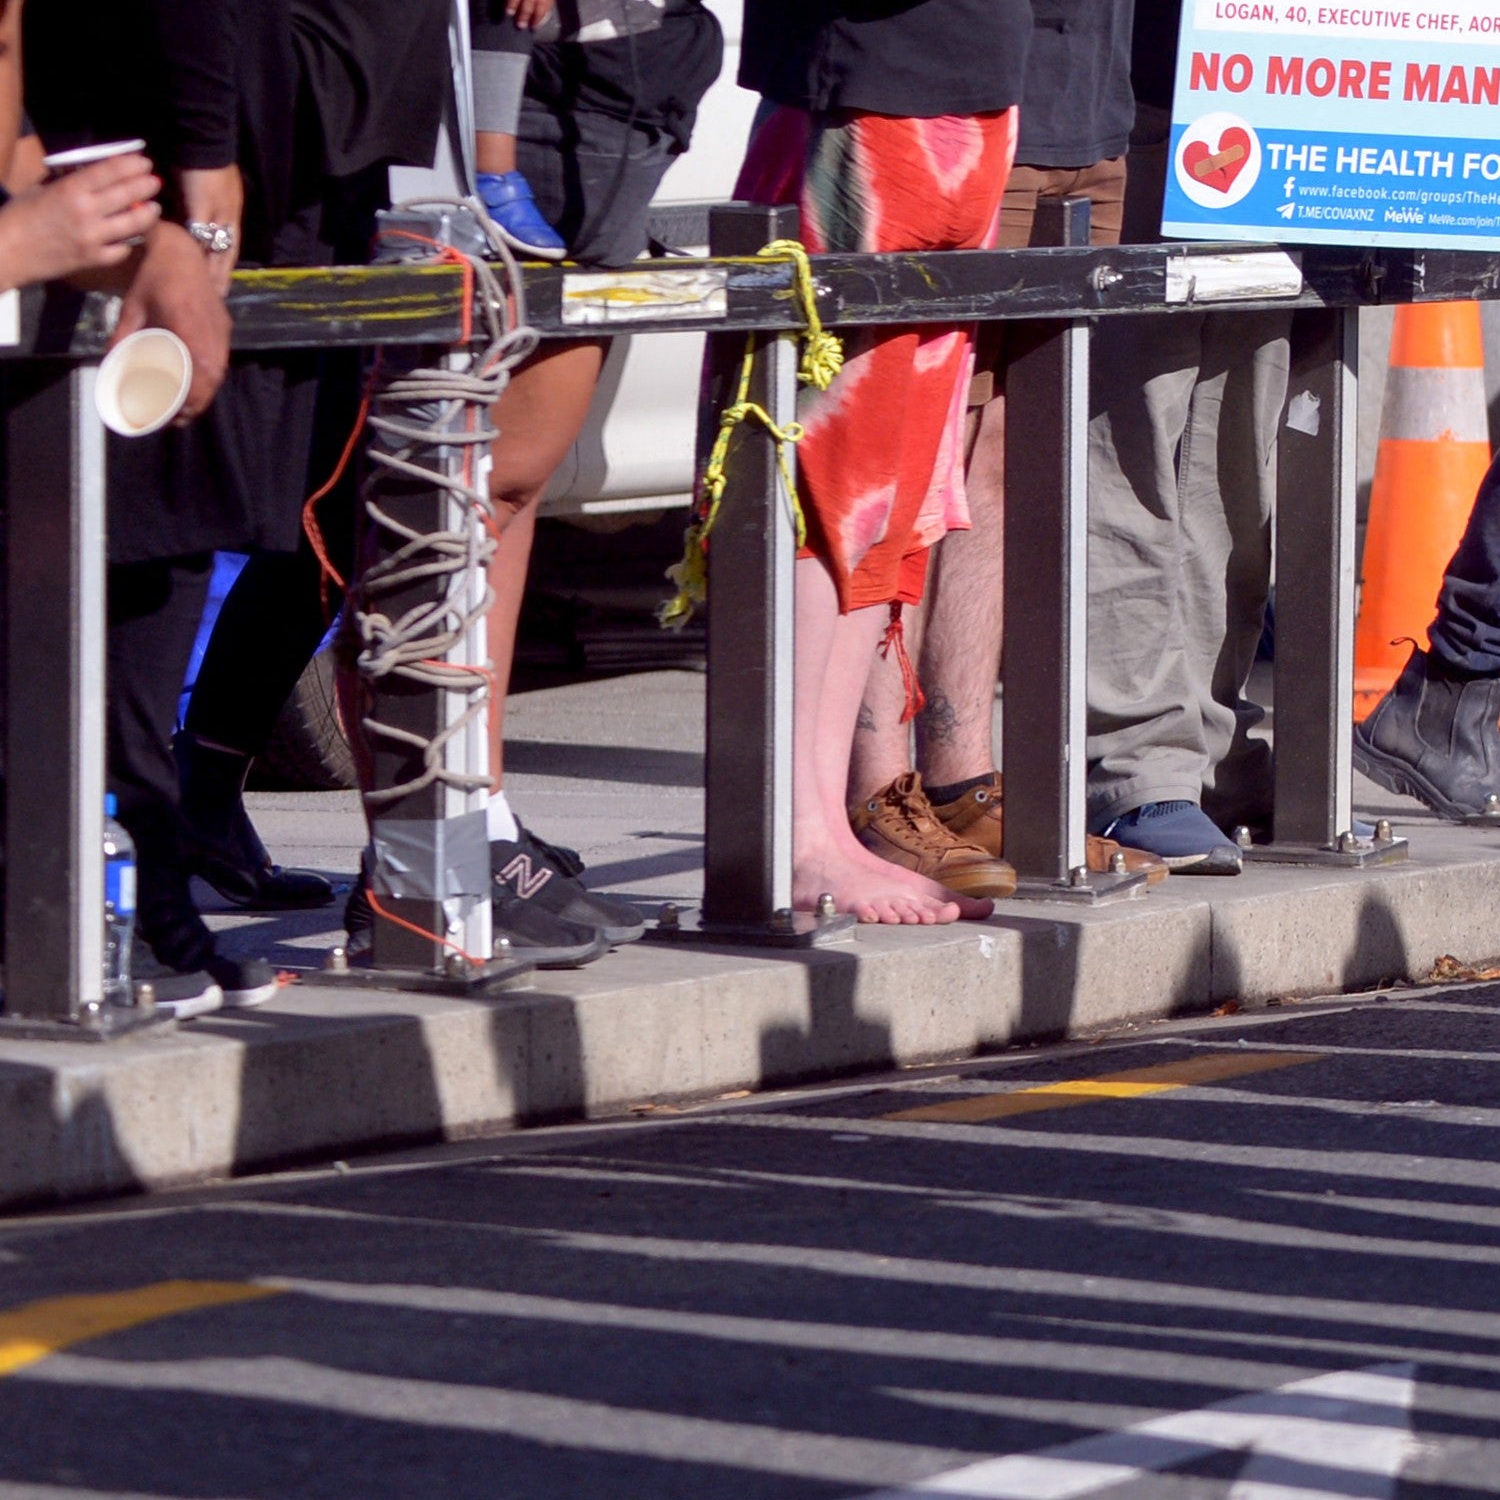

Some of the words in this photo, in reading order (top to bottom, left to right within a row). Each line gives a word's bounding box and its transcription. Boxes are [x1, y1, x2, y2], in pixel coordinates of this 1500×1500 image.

[1216, 2, 1279, 23] LOGAN,
[1285, 6, 1311, 26] 40,
[1317, 8, 1411, 28] EXECUTIVE
[1416, 12, 1463, 33] CHEF,
[1189, 52, 1254, 93] NO
[1265, 56, 1392, 100] MORE
[1266, 143, 1328, 172] THE
[1335, 146, 1454, 179] HEALTH
[1298, 205, 1375, 222] T.ME/COVAXNZ
[1384, 206, 1424, 224] MeWe
